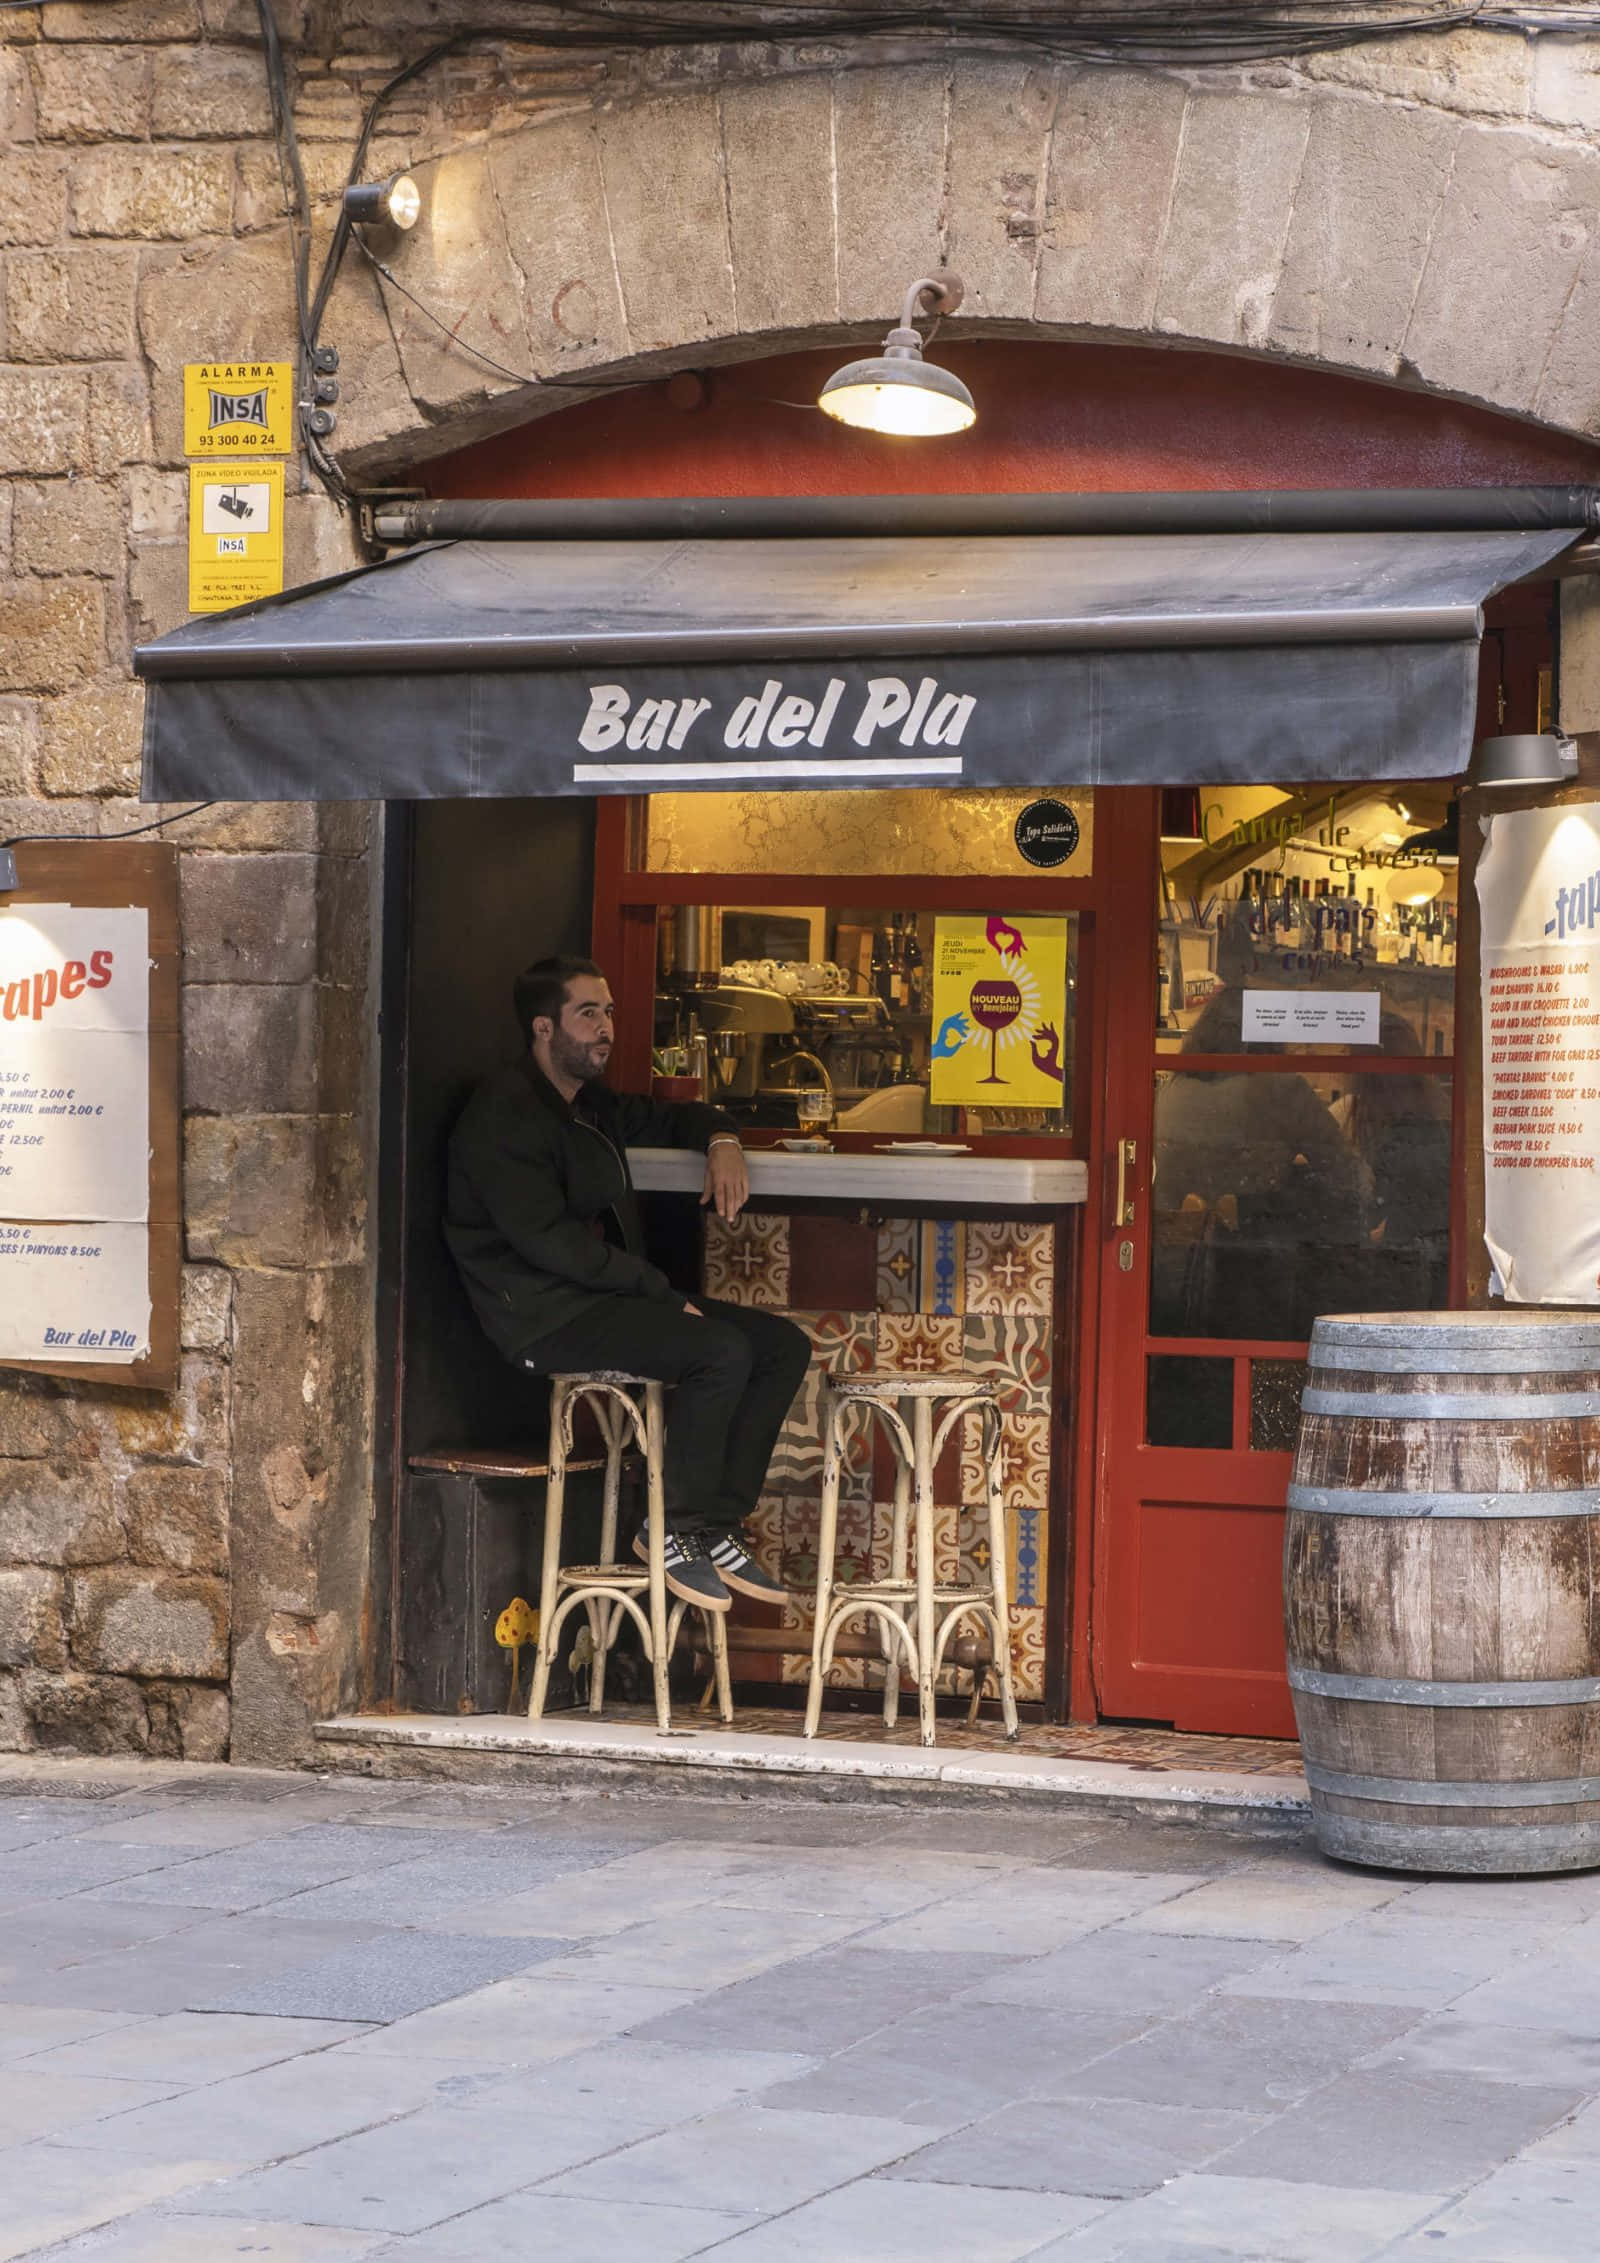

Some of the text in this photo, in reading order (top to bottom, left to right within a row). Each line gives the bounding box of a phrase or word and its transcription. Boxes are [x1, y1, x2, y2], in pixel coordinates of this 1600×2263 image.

[201, 366, 274, 378] ALARMA
[213, 394, 264, 424] INSA
[200, 434, 275, 446] 93 300 40 24
[196, 470, 216, 478] ZONA
[243, 468, 278, 477] VIGILADA
[219, 538, 244, 552] INSA
[577, 677, 977, 753] Bar del Pla
[1201, 797, 1351, 871] Canya de
[1490, 965, 1532, 979] MUSHROOMS
[0, 951, 113, 1021] apes
[1491, 985, 1505, 995] HAM
[972, 994, 1020, 1004] NOUVEAU
[1491, 1001, 1510, 1013] SQUID
[1533, 998, 1570, 1011] CROQUETTE
[1491, 1018, 1505, 1029] HAM
[1507, 1017, 1520, 1028] AND
[1521, 1016, 1541, 1028] ROAST
[1543, 1015, 1570, 1027] CHICKEN
[1491, 1035, 1507, 1046] TUNA
[1509, 1034, 1534, 1045] TARTARE
[1492, 1052, 1506, 1063] BEEF
[1508, 1051, 1533, 1062] TARTARE
[1534, 1050, 1551, 1062] WITH
[1552, 1050, 1566, 1061] FOIE
[1567, 1049, 1585, 1060] GRAS
[10, 1088, 38, 1098] unitat
[40, 1089, 65, 1099] 2.00
[1492, 1089, 1519, 1100] SMOKED
[1520, 1089, 1552, 1100] SARDINES
[0, 1103, 33, 1114] PERNIL
[39, 1104, 67, 1114] unitat
[68, 1105, 93, 1116] 2.00
[1492, 1106, 1507, 1118] BEEF
[1508, 1106, 1530, 1117] CHEEK
[1493, 1123, 1518, 1134] IBERIAN
[1519, 1123, 1536, 1134] PORK
[1537, 1122, 1556, 1134] SLICE
[1493, 1140, 1522, 1151] OCTOPUS
[1519, 1157, 1532, 1168] AND
[1533, 1156, 1570, 1168] CHICKPEAS
[26, 1245, 68, 1256] PINYONS
[70, 1246, 102, 1257] 8.50€
[44, 1328, 137, 1347] Bar del Pla
